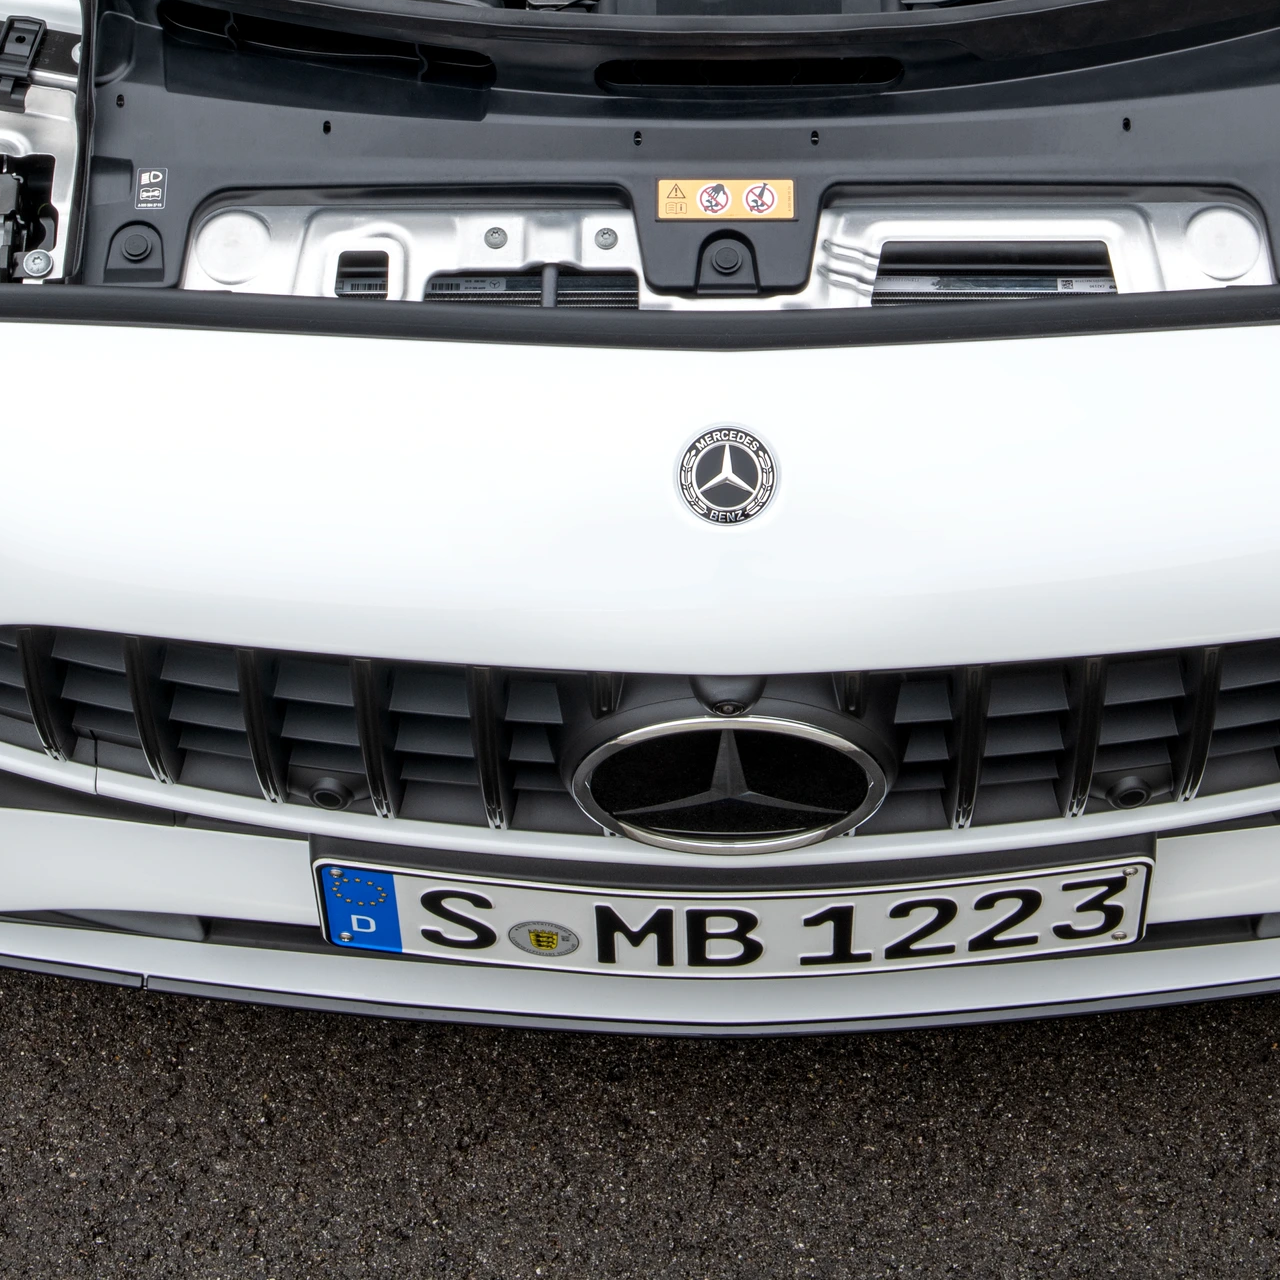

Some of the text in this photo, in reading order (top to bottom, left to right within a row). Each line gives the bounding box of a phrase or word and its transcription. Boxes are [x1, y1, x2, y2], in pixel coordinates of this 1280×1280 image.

[695, 430, 760, 451] MERCEDES
[709, 510, 745, 522] BENZ
[351, 915, 377, 934] D
[420, 876, 1127, 967] S MB 1223
